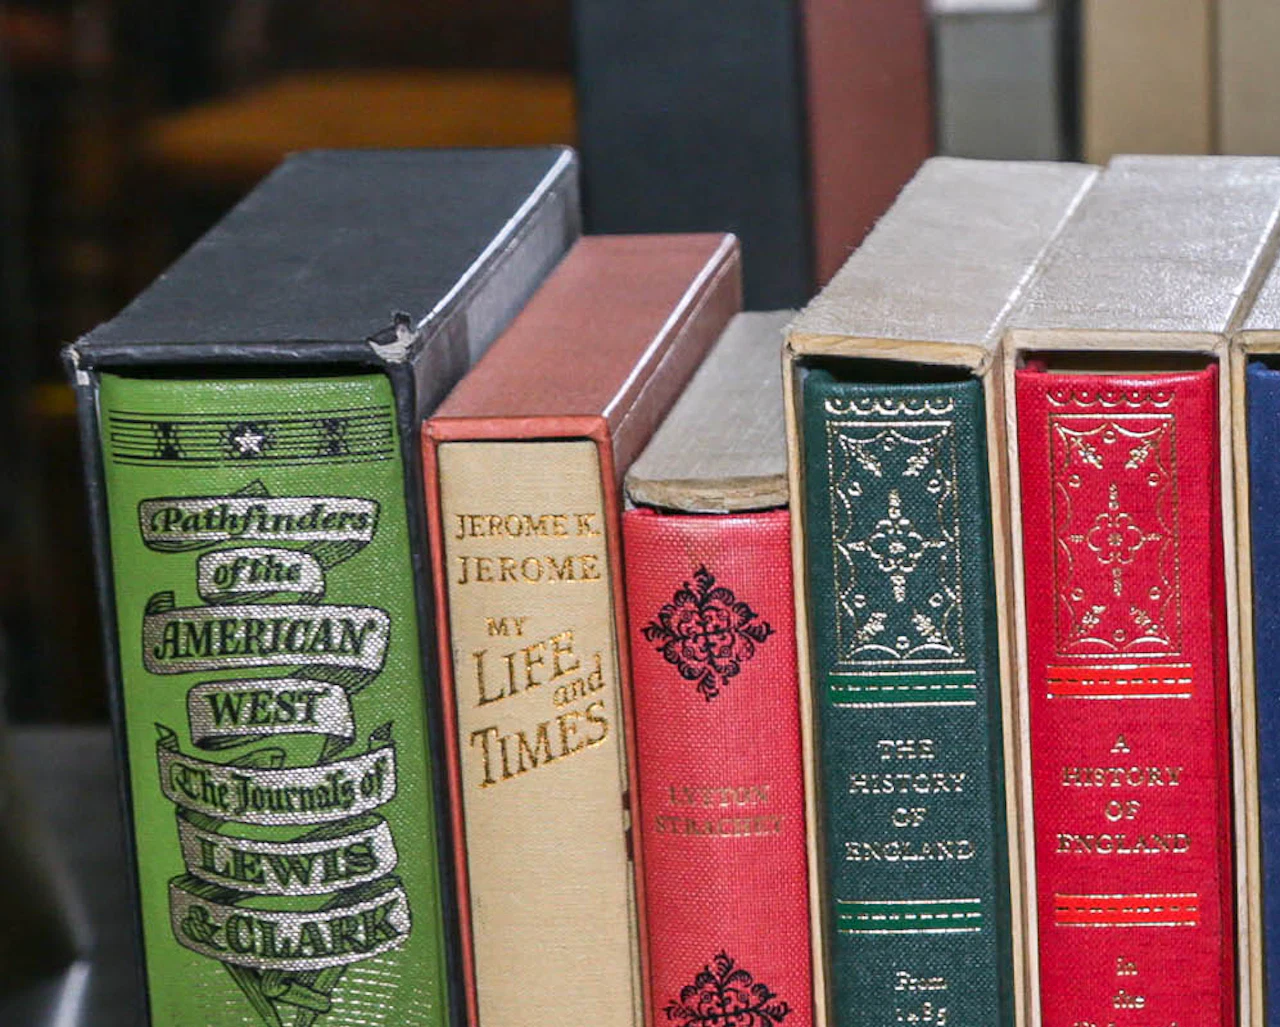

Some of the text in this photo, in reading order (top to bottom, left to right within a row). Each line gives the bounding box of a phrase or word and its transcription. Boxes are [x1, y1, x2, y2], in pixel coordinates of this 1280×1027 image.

[151, 503, 369, 535] Pathfinders
[456, 512, 600, 539] JEROME K.
[213, 555, 299, 586] of the
[457, 555, 600, 584] JEROME
[155, 618, 375, 660] AMERICAN
[486, 617, 525, 636] MY
[472, 630, 581, 708] LIFE
[553, 652, 605, 707] and
[209, 688, 330, 726] WEST
[470, 700, 609, 789] TIMES
[878, 740, 935, 759] THE
[1110, 734, 1130, 754] A
[173, 757, 391, 813] The Journals of
[850, 773, 966, 794] HISTORY
[1061, 766, 1184, 787] HISTORY
[891, 808, 928, 827] OF
[1104, 800, 1141, 821] OF
[845, 841, 976, 861] ENGLAND
[1056, 834, 1191, 853] ENGLAND
[198, 837, 376, 886] LEWIS
[224, 899, 403, 958] CLARK
